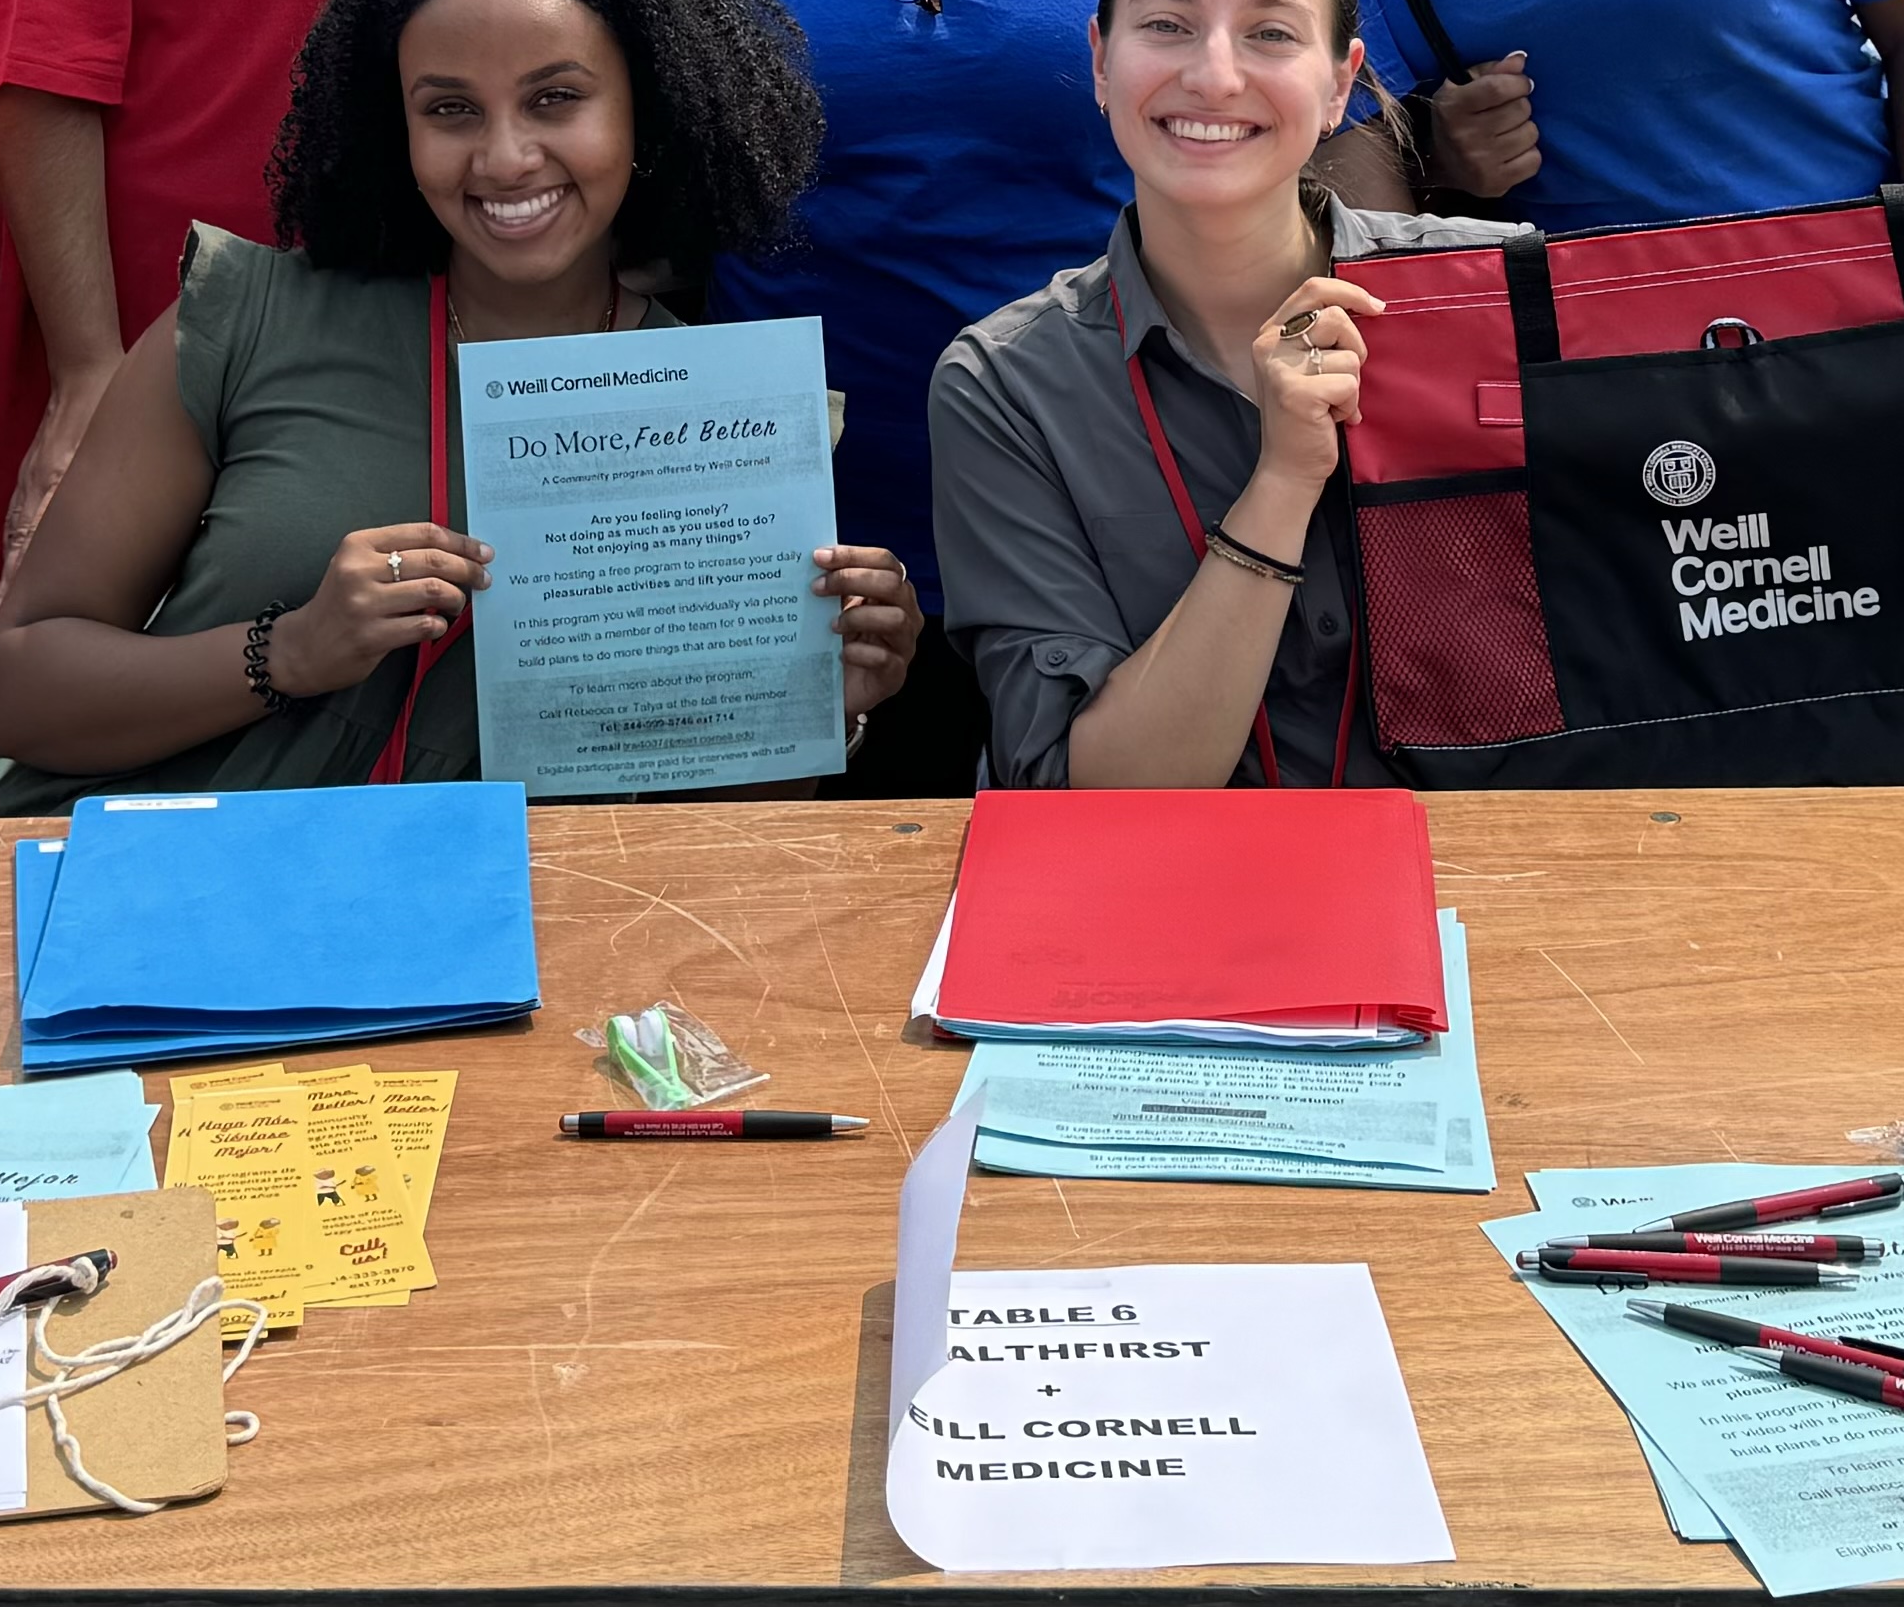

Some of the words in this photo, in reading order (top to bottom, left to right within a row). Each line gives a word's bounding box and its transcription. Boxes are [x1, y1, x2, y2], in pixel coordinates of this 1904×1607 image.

[508, 378, 548, 396] Weill
[551, 373, 611, 392] Cornell
[613, 367, 688, 386] Medicine
[508, 436, 547, 459] Do
[554, 430, 631, 455] More,
[634, 422, 688, 448] Feel
[700, 418, 777, 442] Better
[546, 532, 566, 543] Not
[569, 530, 604, 542] doing
[608, 530, 620, 538] as
[625, 524, 658, 536] much
[662, 524, 676, 533] as
[679, 522, 702, 535] you
[706, 517, 734, 529] used
[738, 516, 750, 526] to
[754, 514, 775, 525] do?
[591, 514, 612, 525] Are
[615, 514, 638, 526] you
[641, 508, 682, 522] feeling
[685, 504, 728, 518] lonely?
[572, 544, 594, 555] Not
[597, 540, 649, 555] enjoying
[652, 540, 666, 548] as
[670, 536, 702, 548] many
[706, 530, 750, 544] things?
[1661, 512, 1770, 554] Weill
[510, 574, 528, 585] We
[532, 573, 550, 583] are
[554, 568, 594, 582] hosting
[609, 565, 630, 576] free
[634, 562, 680, 574] program
[684, 560, 695, 570] to
[698, 555, 746, 568] increase
[749, 554, 772, 566] your
[776, 550, 802, 562] daily
[1671, 545, 1831, 596] Cornell
[544, 584, 613, 601] pleasurable
[617, 580, 670, 593] activities
[674, 576, 694, 587] and
[698, 574, 714, 585] lift
[717, 573, 744, 587] your
[747, 569, 782, 581] mood
[514, 620, 526, 630] In
[529, 616, 549, 628] this
[552, 614, 600, 629] program
[603, 611, 624, 624] you
[627, 607, 644, 618] will
[648, 606, 676, 616] meet
[678, 599, 740, 615] individually
[744, 598, 760, 608] via
[764, 594, 798, 608] phone
[1678, 586, 1881, 642] Medicine
[520, 638, 531, 647] or
[534, 634, 565, 647] video
[568, 632, 592, 643] with
[605, 626, 650, 640] member
[654, 624, 664, 634] of
[668, 623, 686, 634] the
[688, 620, 716, 632] team
[720, 617, 734, 628] for
[748, 614, 784, 626] weeks
[787, 612, 798, 622] to
[518, 656, 545, 668] build
[548, 653, 579, 667] plans
[582, 652, 593, 662] to
[596, 650, 611, 660] do
[614, 648, 642, 659] more
[646, 642, 680, 657] things
[682, 640, 704, 652] that
[708, 640, 725, 650] are
[728, 635, 753, 648] best
[756, 634, 770, 645] for
[340, 1237, 386, 1256] Call
[947, 1306, 1095, 1325] TABLE
[1111, 1304, 1137, 1321] 6
[948, 1341, 1211, 1362] ALTHFIRST
[1037, 1385, 1061, 1397] +
[1023, 1417, 1257, 1438] CORNELL
[936, 1458, 1185, 1481] MEDICINE
[1835, 1542, 1894, 1559] Eligible
